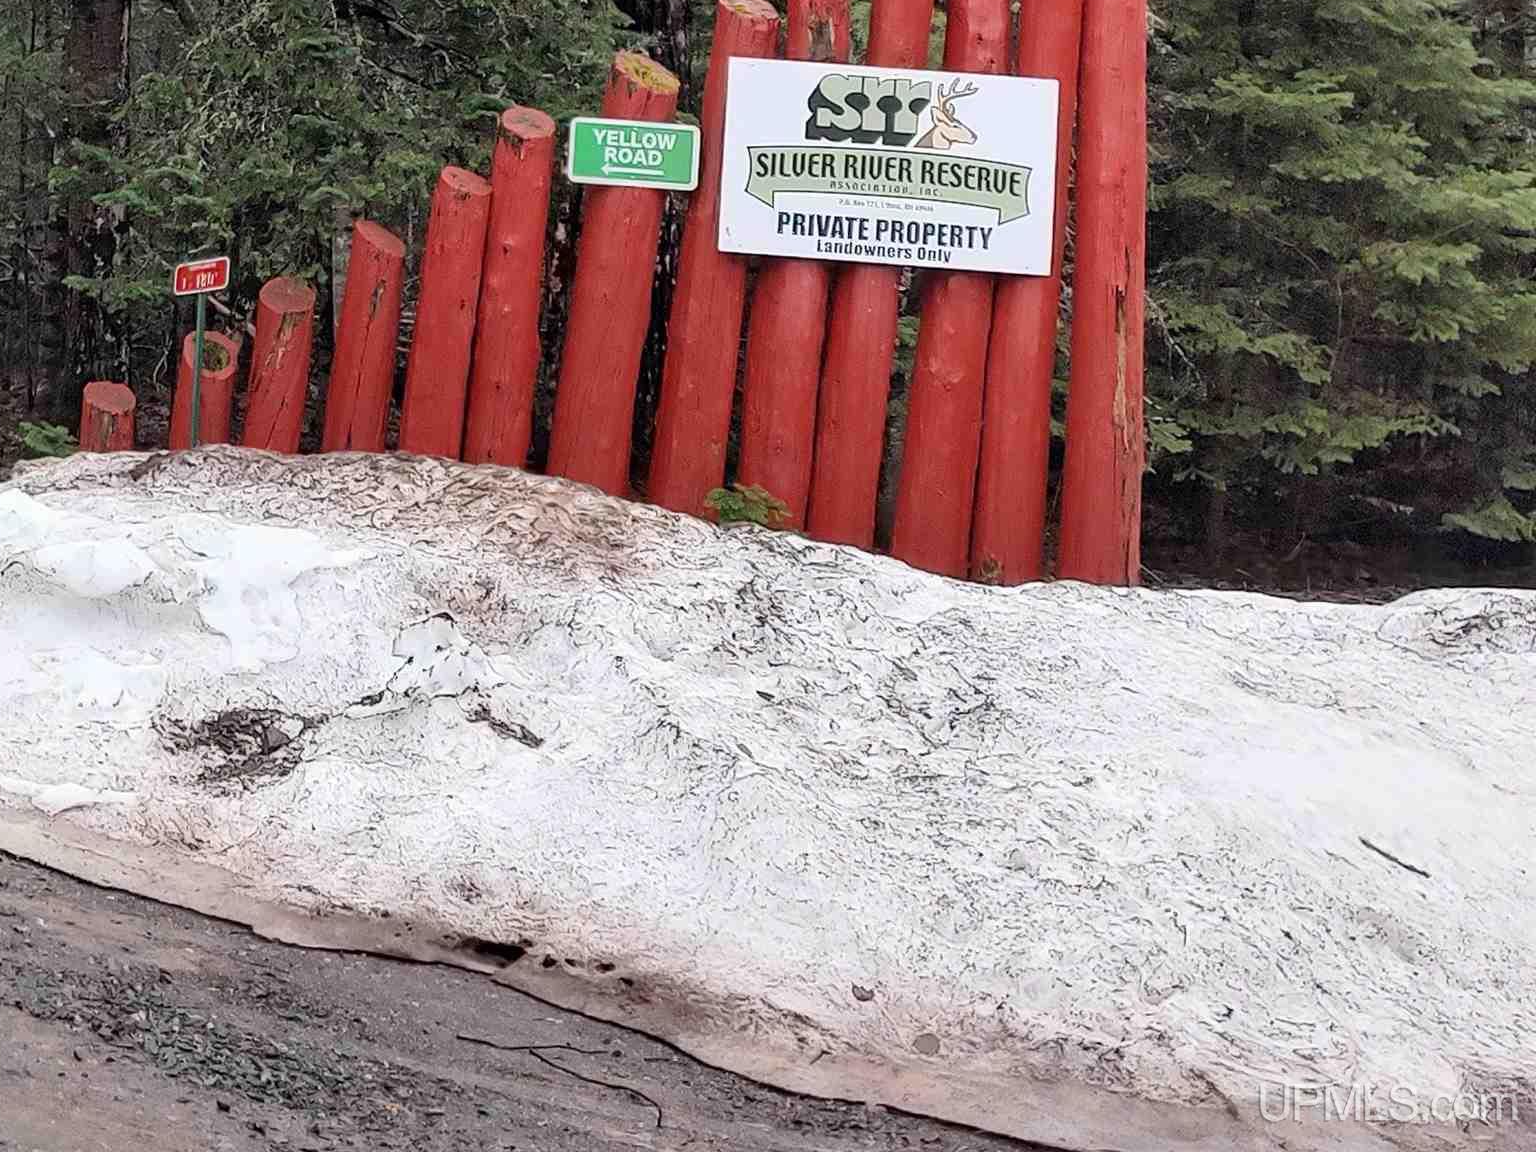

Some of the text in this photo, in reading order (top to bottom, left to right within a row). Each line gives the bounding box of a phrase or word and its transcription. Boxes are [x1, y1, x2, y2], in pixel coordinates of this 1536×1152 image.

[593, 129, 676, 150] YELLOW
[604, 148, 663, 166] ROAD
[756, 152, 1022, 197] SILVER RIVER RESERVE
[777, 212, 993, 249] PRIVATE PROPERTY
[817, 239, 952, 263] Landowners Only
